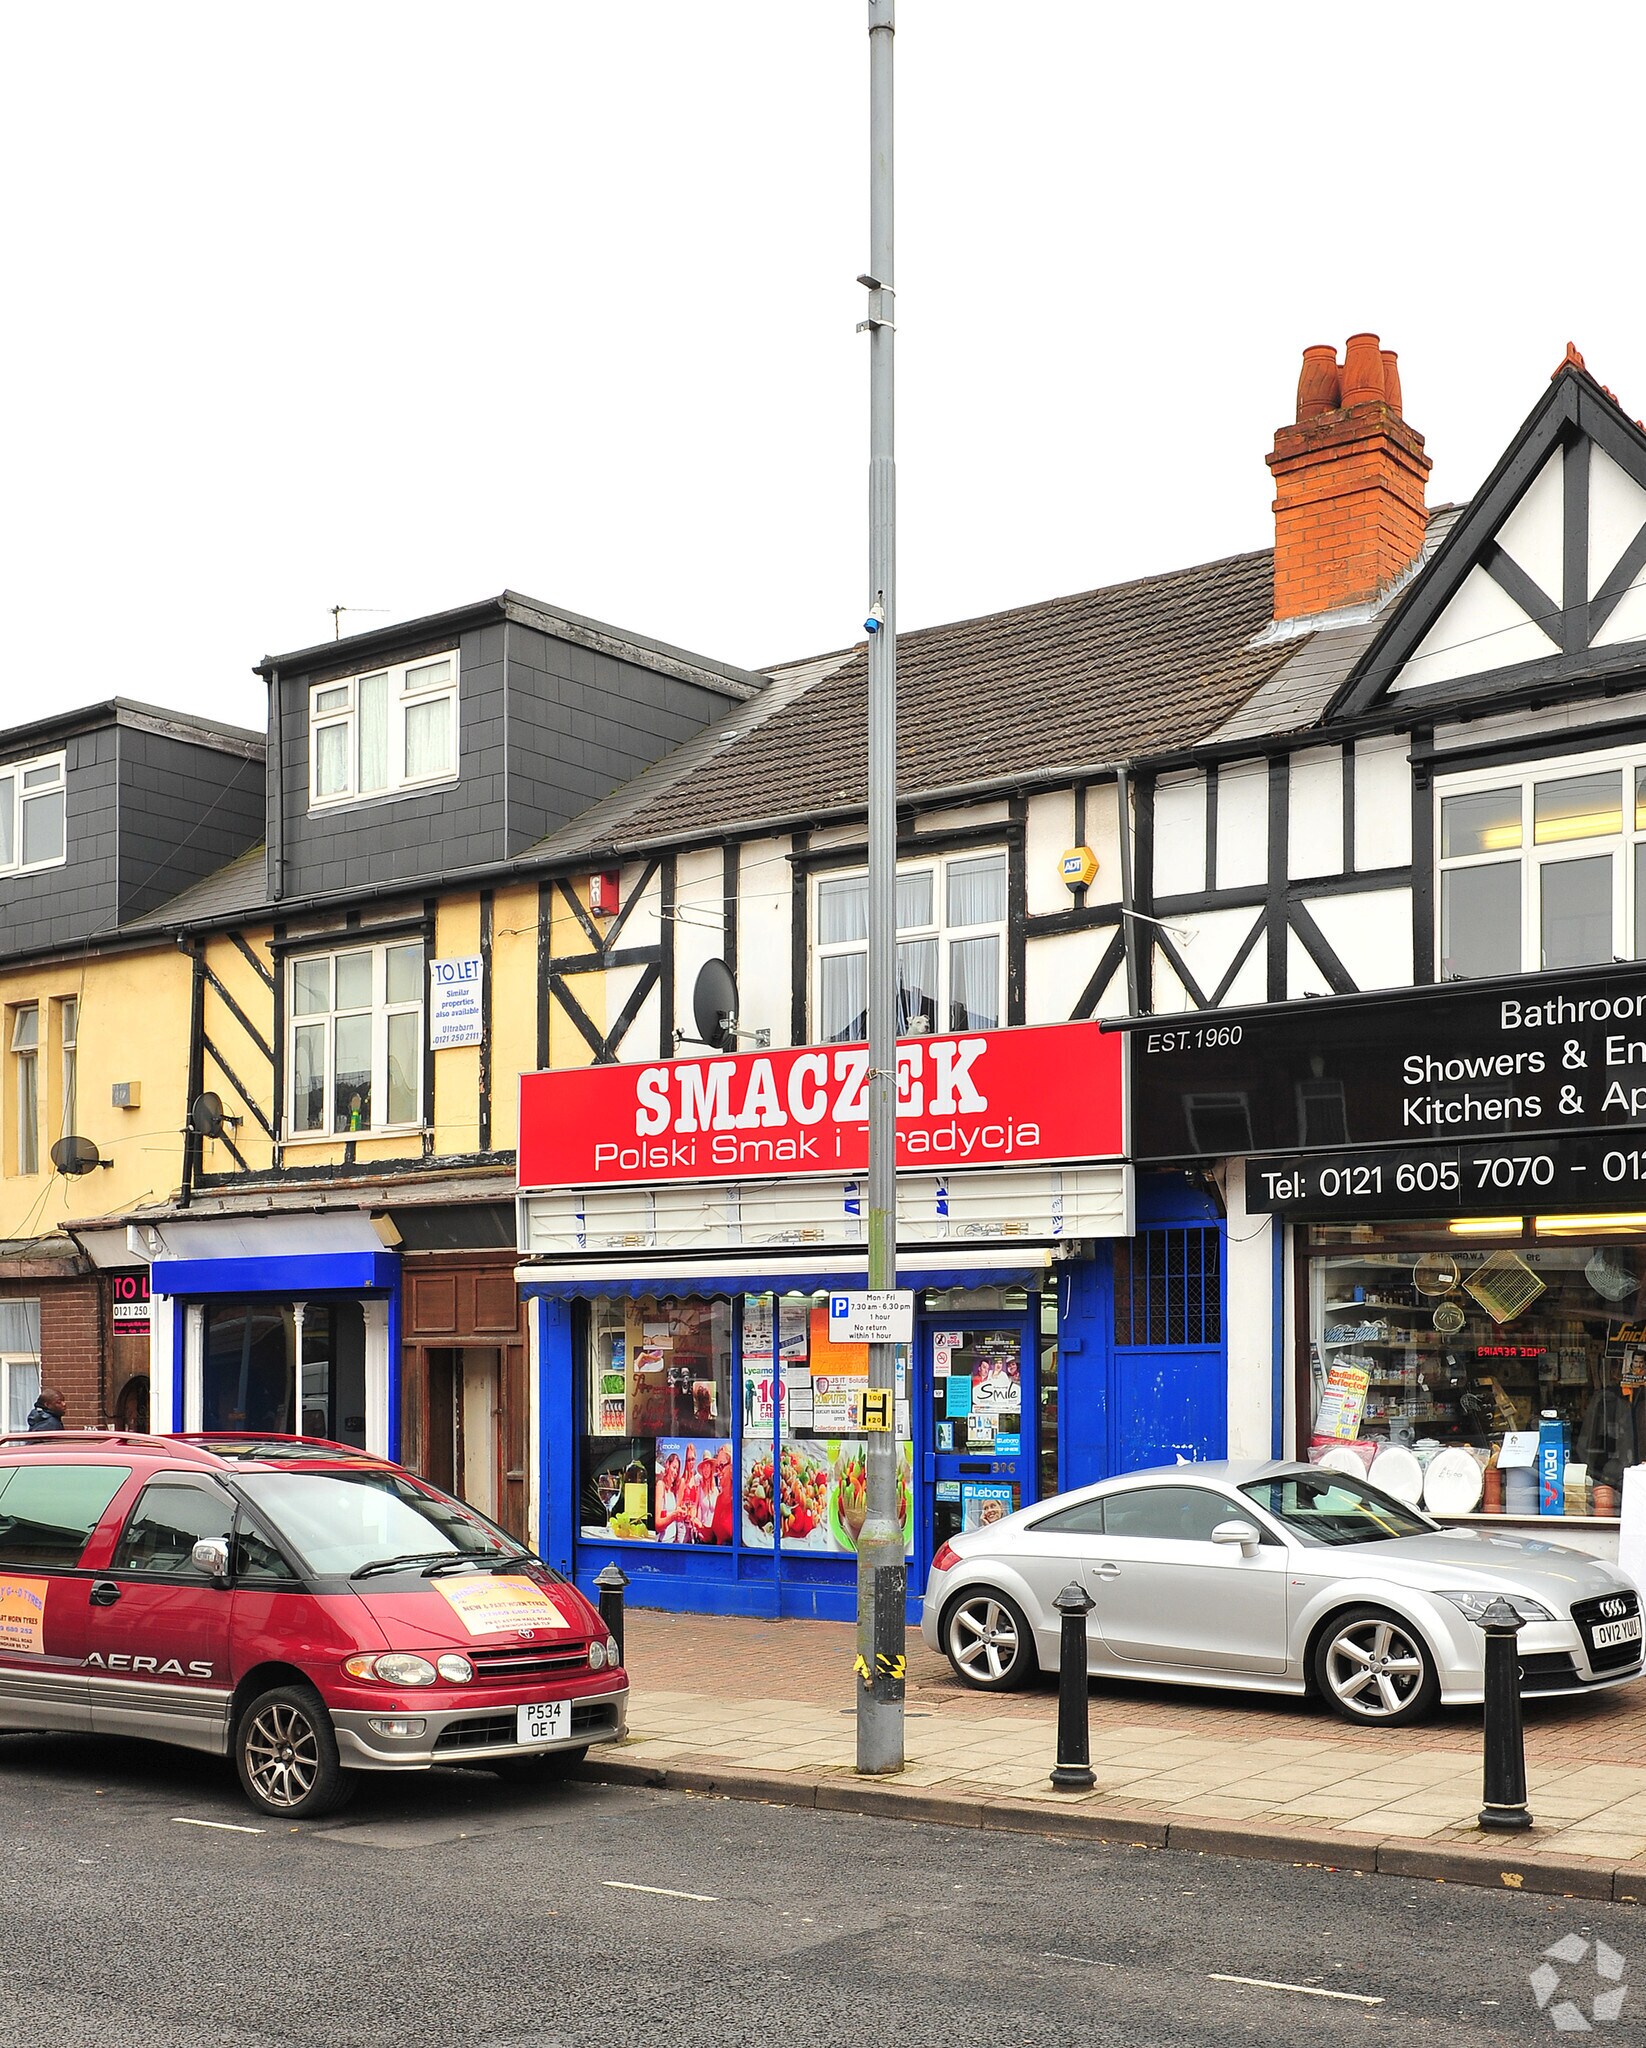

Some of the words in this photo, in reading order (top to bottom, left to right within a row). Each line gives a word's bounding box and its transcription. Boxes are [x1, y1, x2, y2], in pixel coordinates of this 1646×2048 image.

[1064, 860, 1081, 871] ADT
[435, 964, 454, 982] TO
[457, 960, 478, 980] LET
[446, 989, 470, 998] Similar
[441, 998, 474, 1009] properties
[451, 1008, 480, 1017] available
[442, 1024, 474, 1034] Ultrabarn
[434, 1035, 449, 1044] 0121
[451, 1034, 465, 1042] 250
[466, 1032, 480, 1040] 2111
[1403, 1051, 1546, 1085] Showers
[1562, 1040, 1588, 1070] &
[636, 1038, 988, 1136] SMACZEK
[1403, 1094, 1542, 1126] Kitchens
[1558, 1084, 1584, 1114] &
[594, 1138, 696, 1172] Polski
[712, 1130, 819, 1164] Smak
[835, 1128, 841, 1157] i
[857, 1116, 1040, 1156] radycja
[1261, 1171, 1306, 1200] Tel:
[1319, 1166, 1382, 1196] 0121
[1396, 1162, 1459, 1192] 605
[1473, 1156, 1554, 1188] 7070
[1602, 1151, 1646, 1182] 01
[114, 1277, 136, 1298] TO
[114, 1306, 131, 1316] 0121
[134, 1306, 148, 1315] 250
[836, 1300, 847, 1316] P
[1330, 1370, 1365, 1381] Radiator
[977, 1382, 1018, 1401] Smile
[1328, 1378, 1366, 1390] Reflector
[862, 1393, 886, 1426] H
[973, 1487, 1010, 1498] Lebara
[23, 1617, 38, 1625] TYRES
[1599, 1624, 1621, 1643] OV12
[80, 1652, 214, 1678] AERAS
[528, 1703, 561, 1720] P534
[532, 1721, 556, 1737] OET
